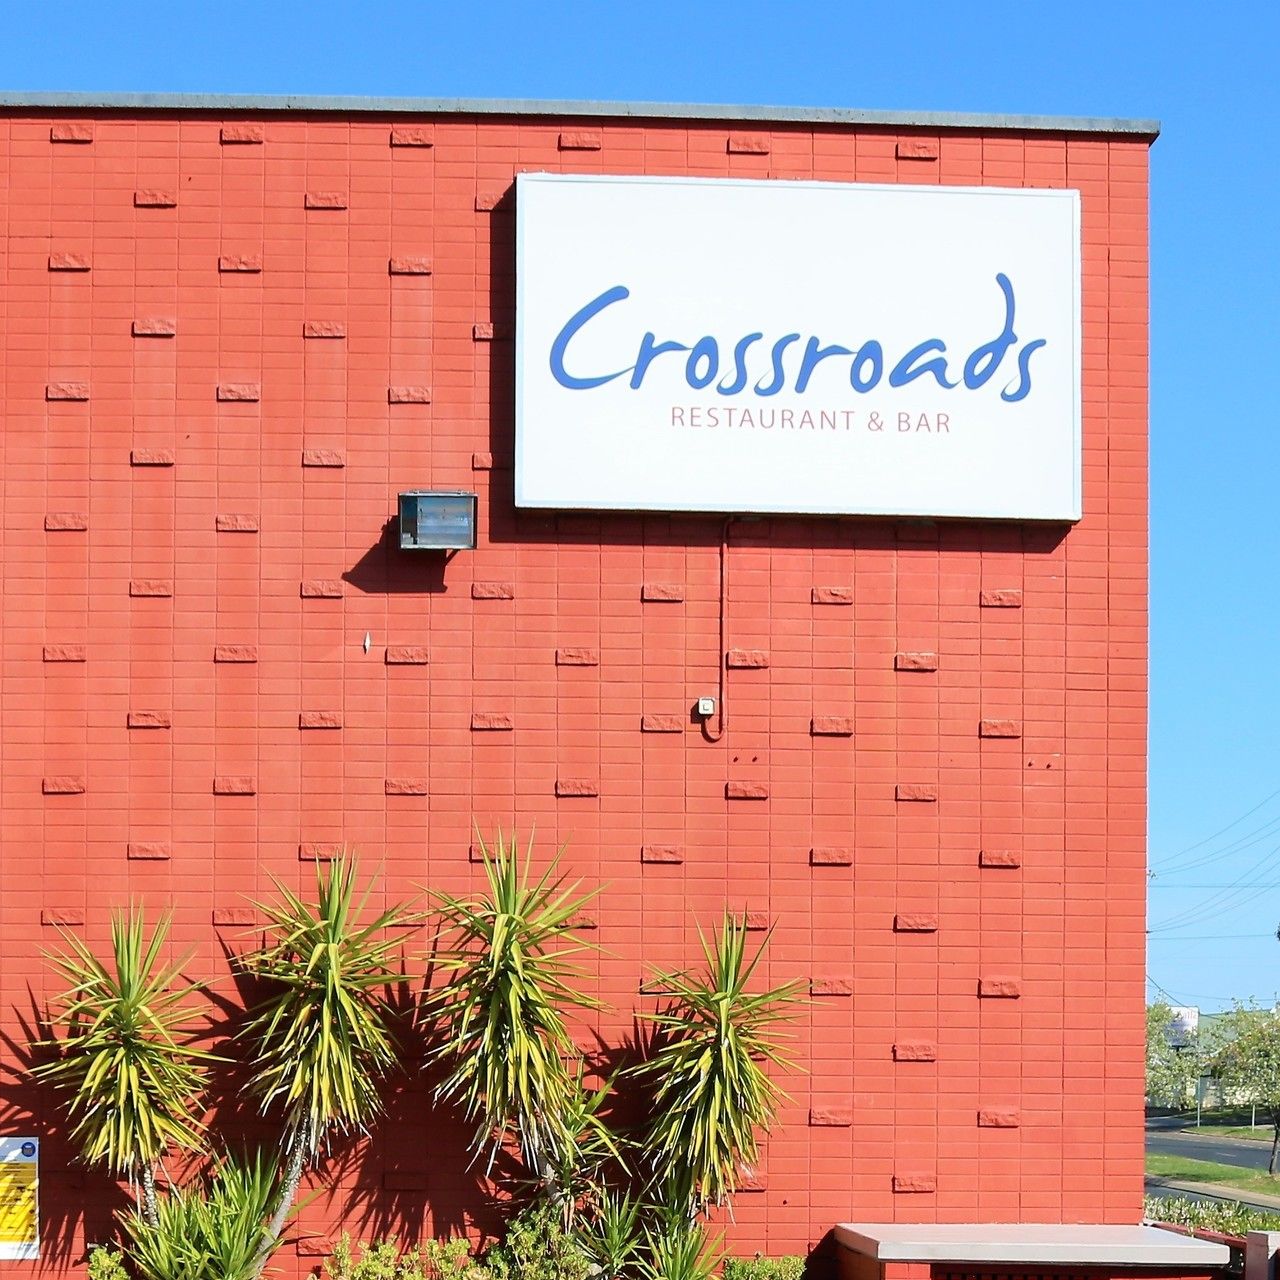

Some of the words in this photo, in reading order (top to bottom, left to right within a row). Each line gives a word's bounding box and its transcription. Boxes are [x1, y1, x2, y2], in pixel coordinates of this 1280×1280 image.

[549, 272, 1047, 403] Crossroads
[670, 405, 856, 432] RESTAURANT
[867, 410, 885, 433] &
[897, 411, 952, 434] BAR
